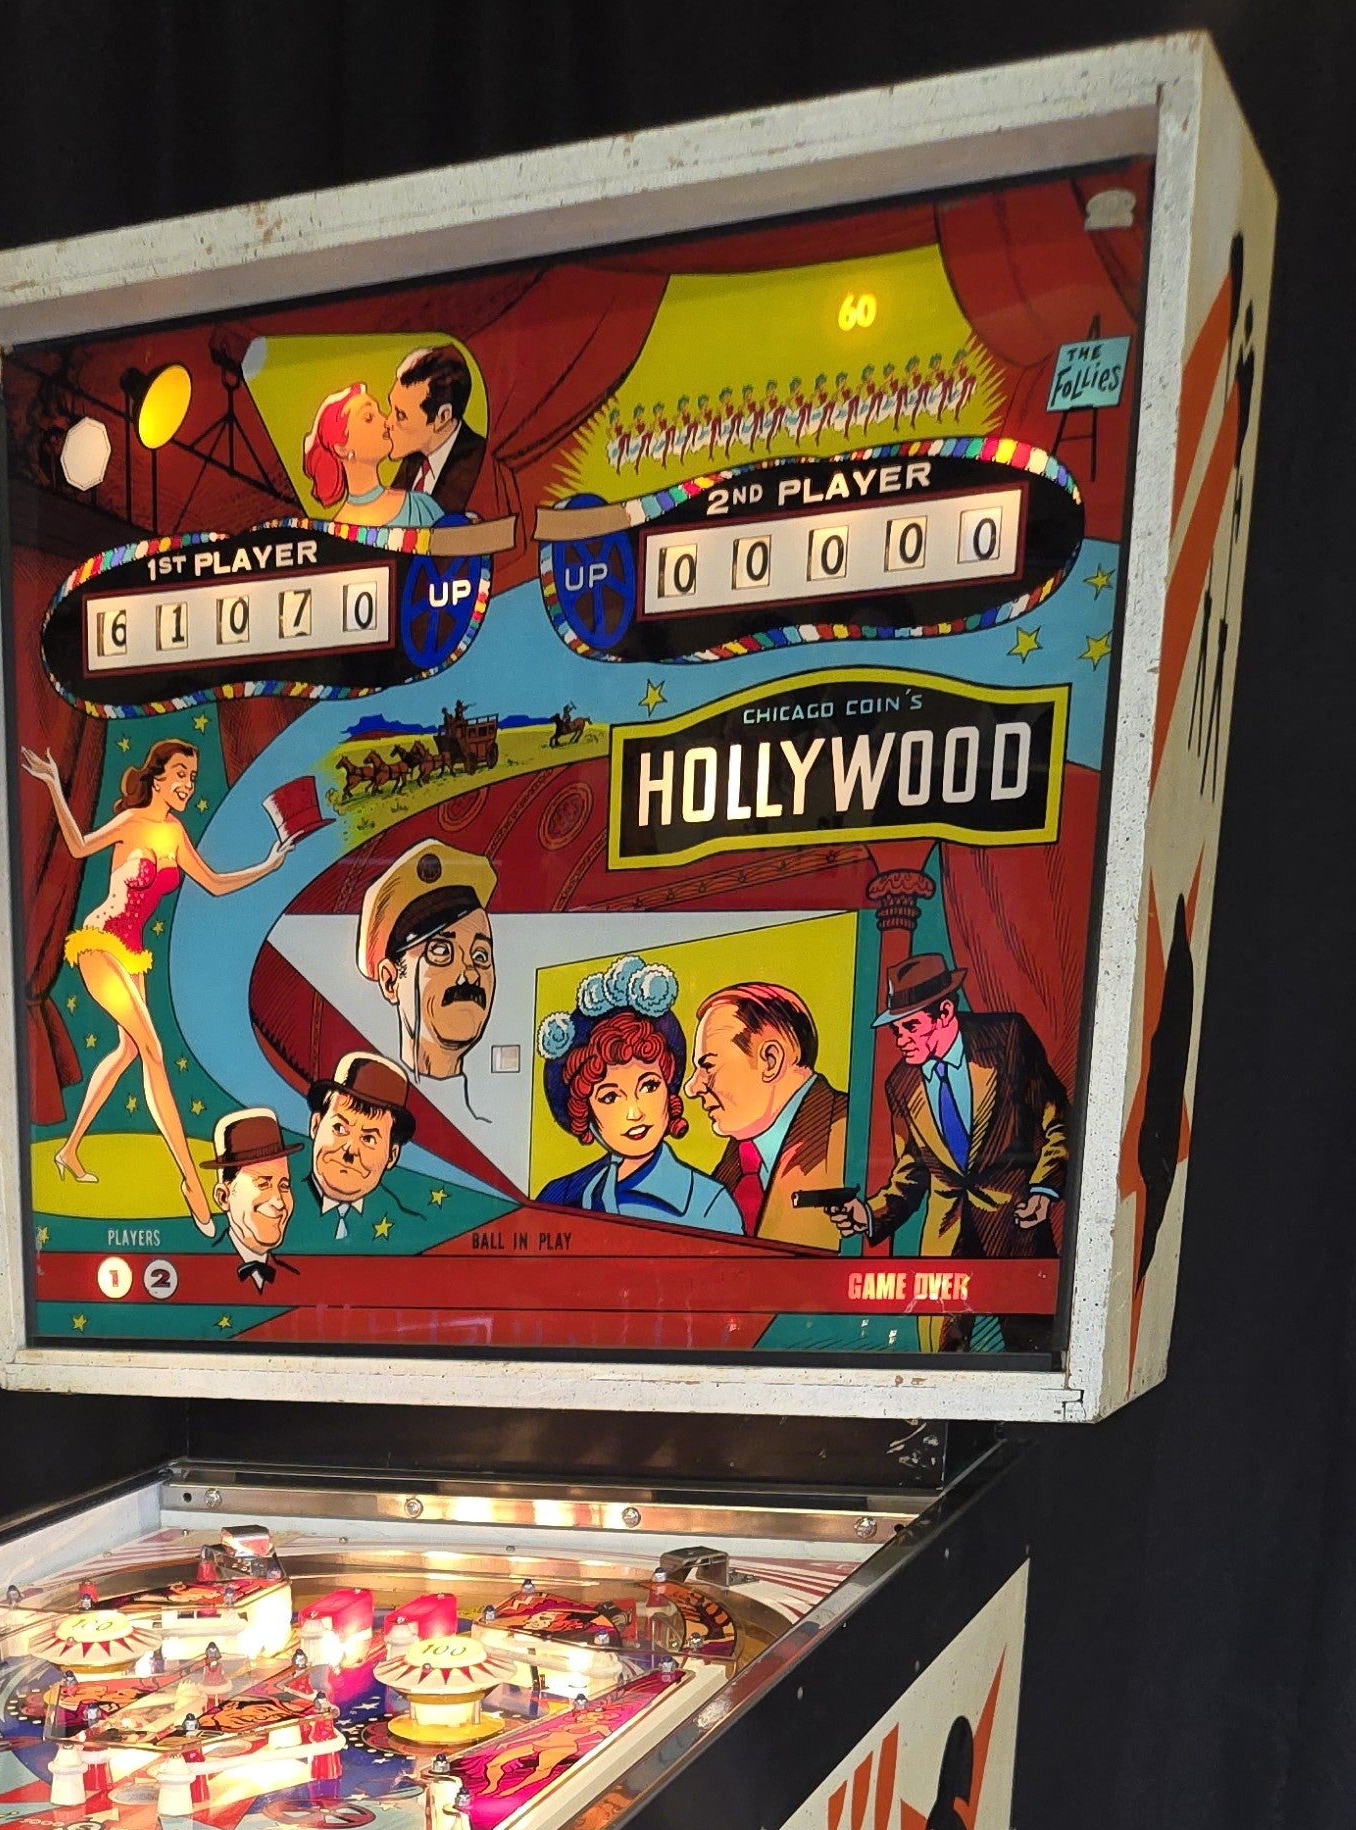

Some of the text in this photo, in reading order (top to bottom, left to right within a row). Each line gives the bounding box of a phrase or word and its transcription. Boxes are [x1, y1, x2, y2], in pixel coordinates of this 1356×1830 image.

[838, 293, 877, 331] 60
[1067, 344, 1102, 361] THE
[706, 461, 932, 516] 2ND PLAYER
[147, 540, 318, 582] 1ST PLAYER
[563, 562, 609, 592] UP
[428, 579, 472, 607] UP
[743, 688, 924, 725] CHICAGO COIN'S
[638, 721, 1032, 827] HOLLYWOOD
[107, 1229, 161, 1246] PLAYERS
[472, 1232, 572, 1250] BALL IN PLAY
[109, 1268, 171, 1288] 1 2
[848, 1272, 971, 1300] GAME OVER
[422, 1643, 467, 1656] 100
